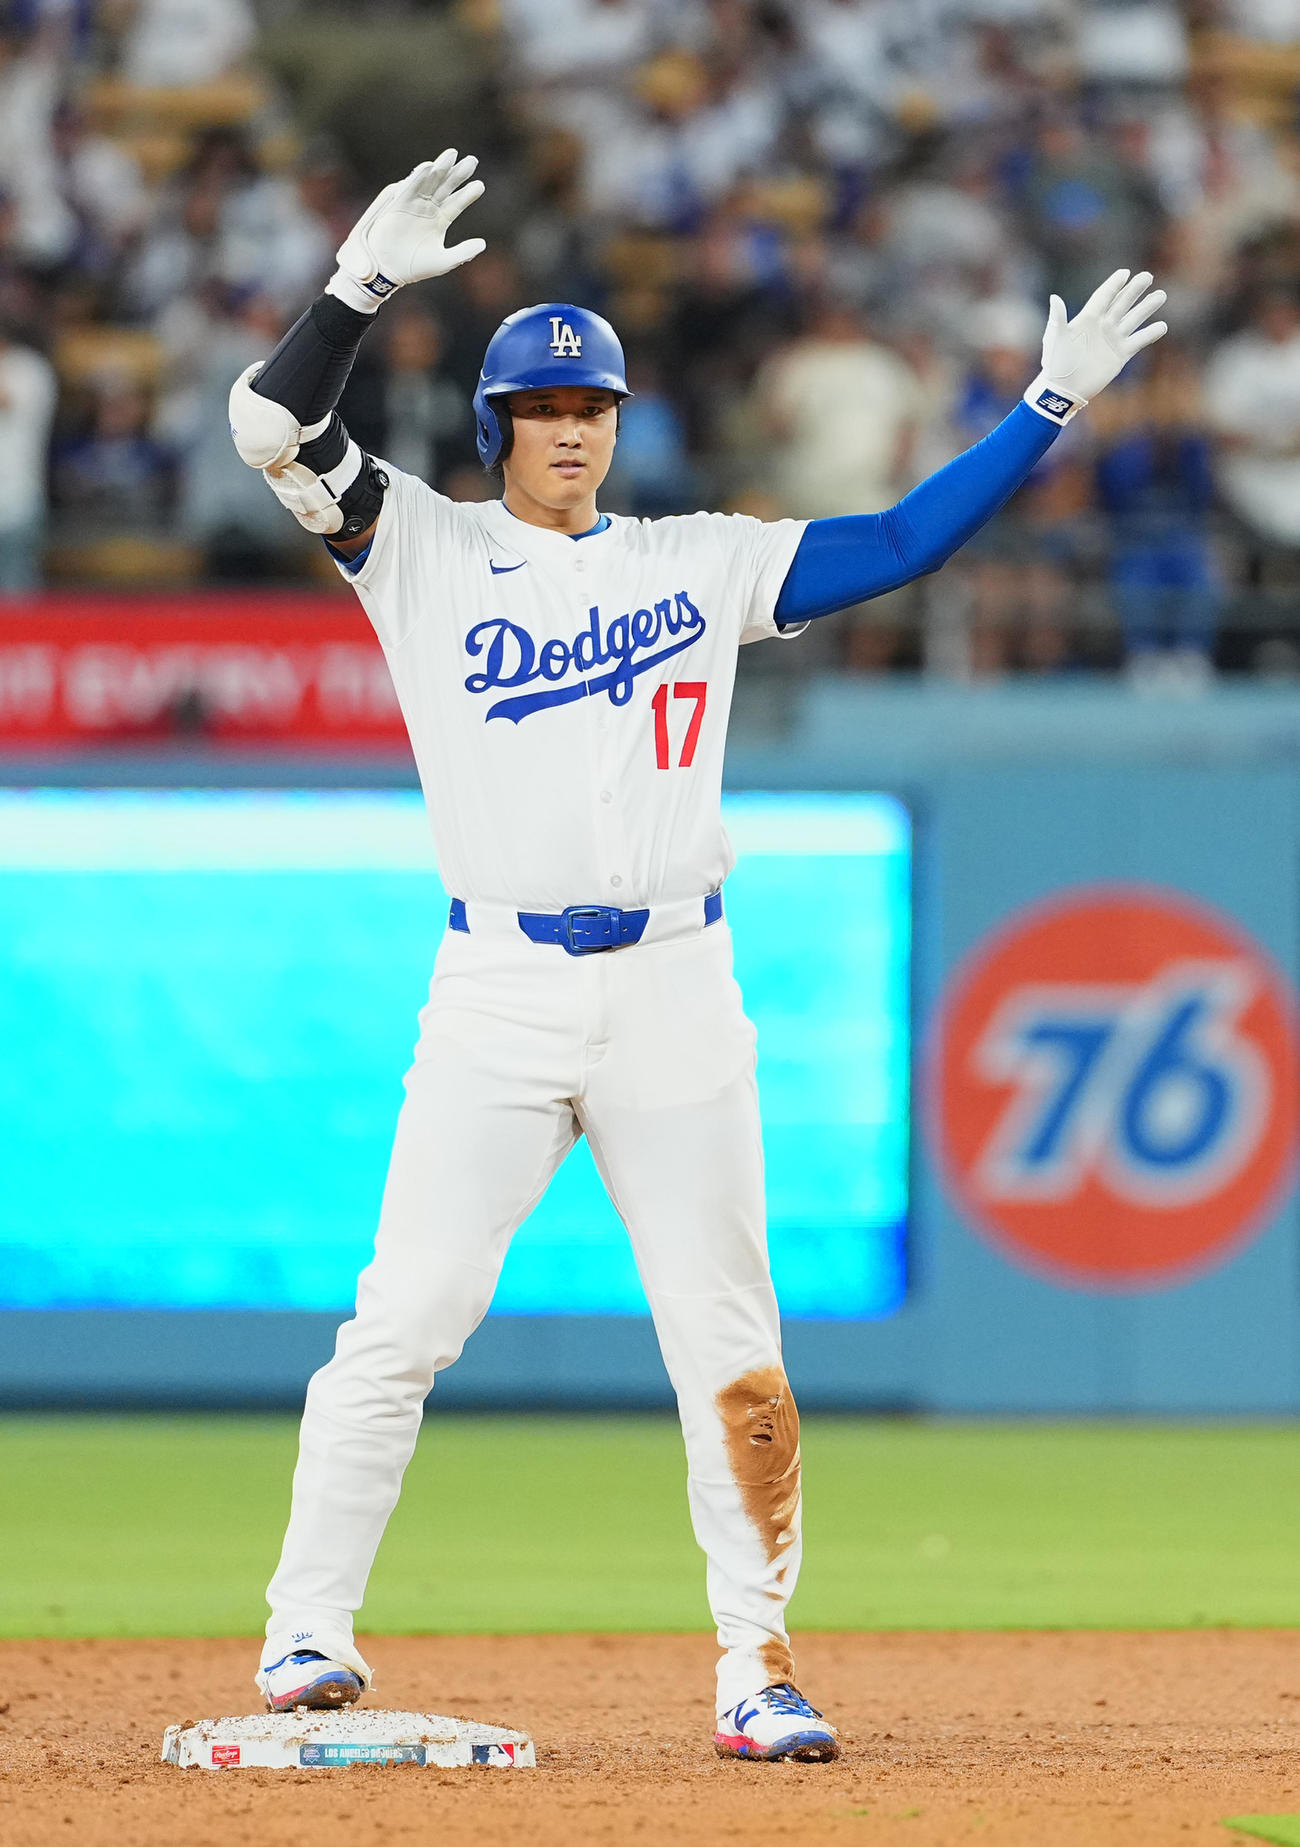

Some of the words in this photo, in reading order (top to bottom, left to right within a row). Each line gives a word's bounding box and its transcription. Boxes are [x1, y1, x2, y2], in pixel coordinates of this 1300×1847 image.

[549, 316, 582, 357] LA
[465, 590, 707, 724] Dodgers
[652, 681, 708, 769] 17
[988, 970, 1260, 1202] 76
[325, 1748, 339, 1758] LOS
